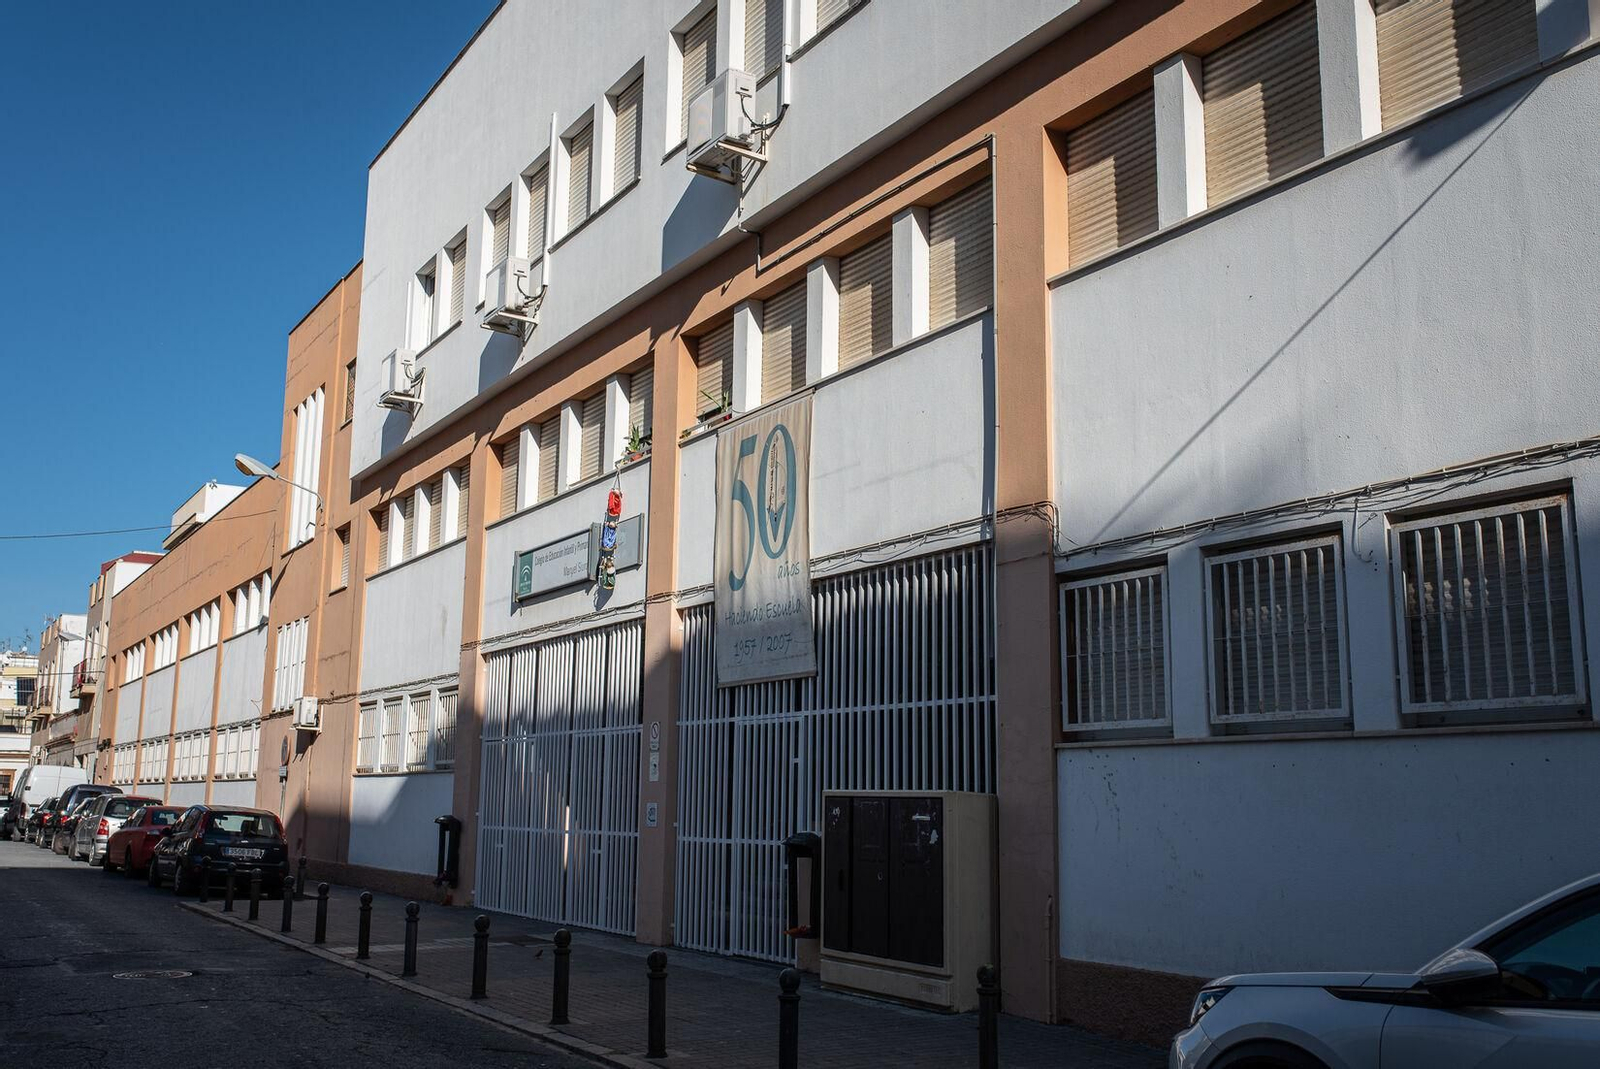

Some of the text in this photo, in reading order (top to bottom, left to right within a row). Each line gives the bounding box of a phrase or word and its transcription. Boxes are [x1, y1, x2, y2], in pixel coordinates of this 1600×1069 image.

[729, 423, 797, 592] 50
[778, 560, 800, 579] años
[725, 596, 802, 626] Haciendo Escuela
[734, 638, 757, 664] 1957
[766, 632, 793, 654] 2007
